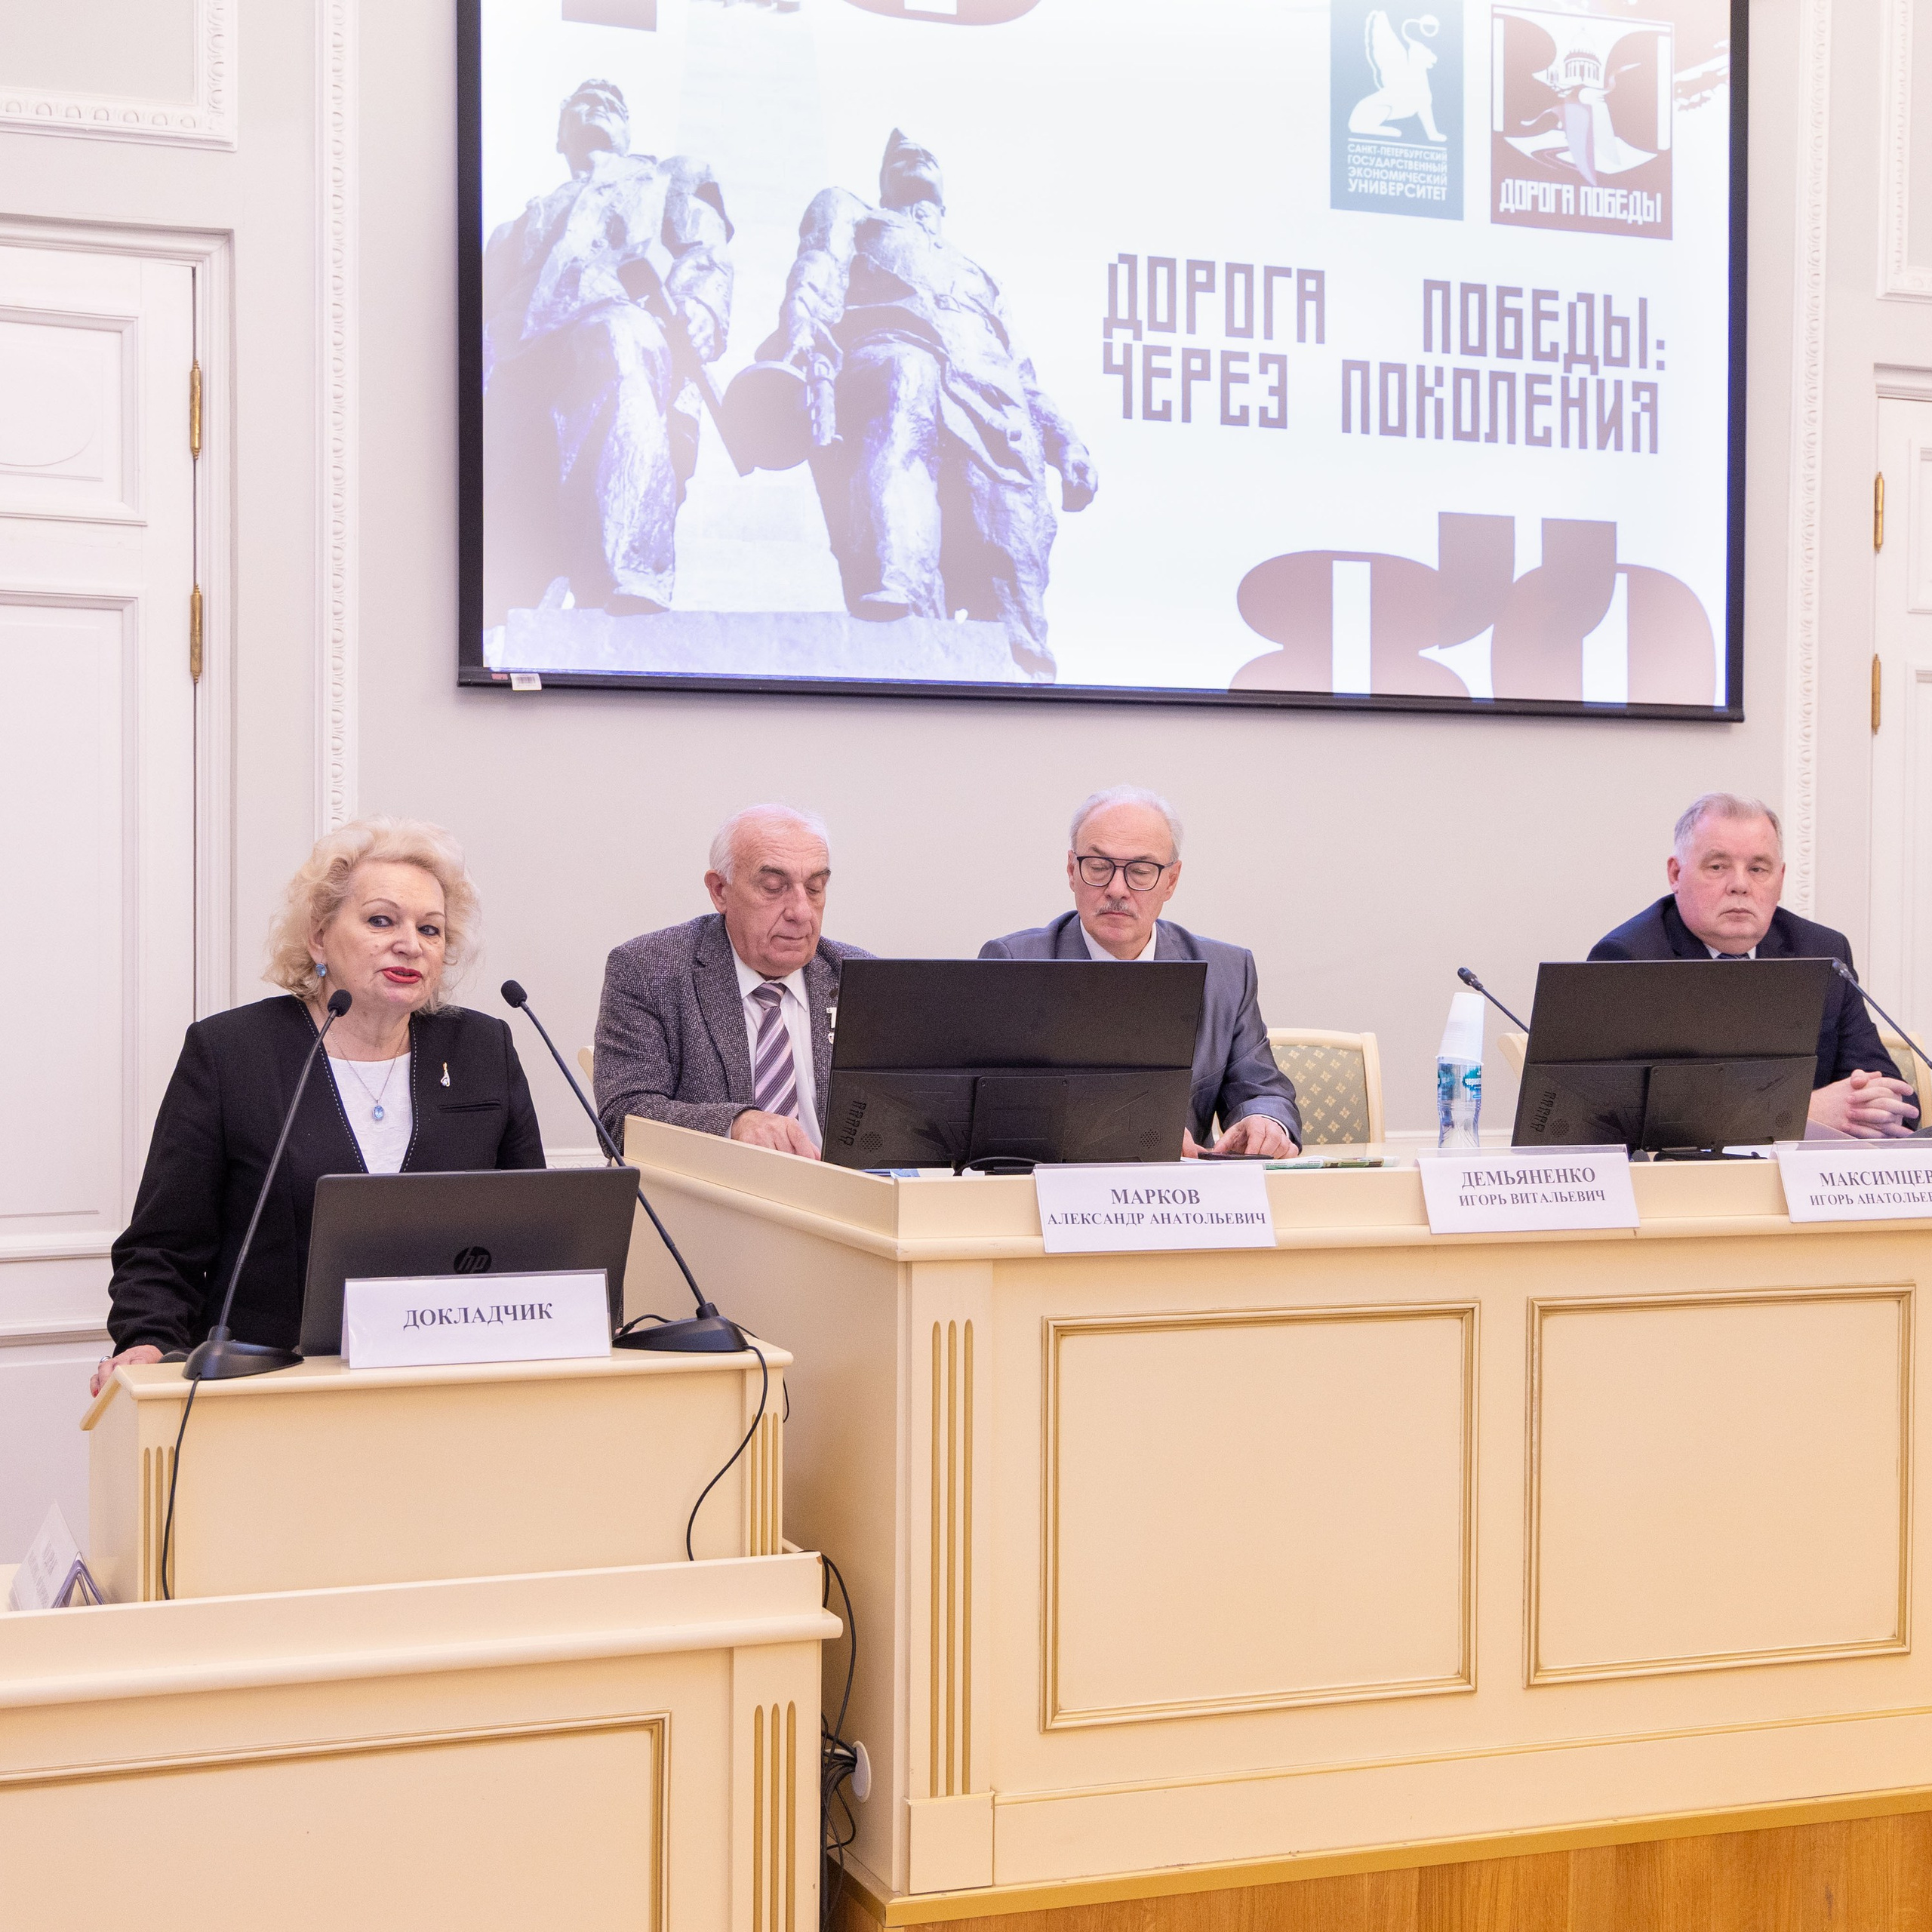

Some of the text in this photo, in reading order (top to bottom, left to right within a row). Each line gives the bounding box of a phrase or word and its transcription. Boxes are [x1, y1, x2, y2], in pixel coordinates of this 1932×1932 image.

[1347, 143, 1447, 162] САНКТ-ПЕТЕРБУРГСКИЙ
[1347, 155, 1447, 173] ГОСУДАРСТВЕННЫЙ
[1347, 166, 1447, 186] ЭКОНОМИЧЕСКИЙ
[1347, 178, 1447, 201] УНИВЕРСИТЕТ
[1499, 178, 1662, 225] ДОРОГА ПОБЕДЫ
[1103, 253, 1666, 377] ДОРОГА ПОБЕДЫ:
[1103, 340, 1659, 454] ЧЕРЕЗ ПОКОЛЕНИЯ
[1461, 1167, 1596, 1190] ДЕМЬЯНЕНКО
[1110, 1188, 1201, 1205] МАРКОВ
[1459, 1189, 1606, 1207] ИГОРЬ ВИТАЛЬЕВИЧ
[1810, 1194, 1854, 1206] ИГОРЬ
[1048, 1212, 1267, 1227] АЛЕКСАНДР АНАТОЛЬЕВИЧ
[455, 1247, 490, 1274] hp
[403, 1303, 553, 1331] ДОКЛАДЧИК
